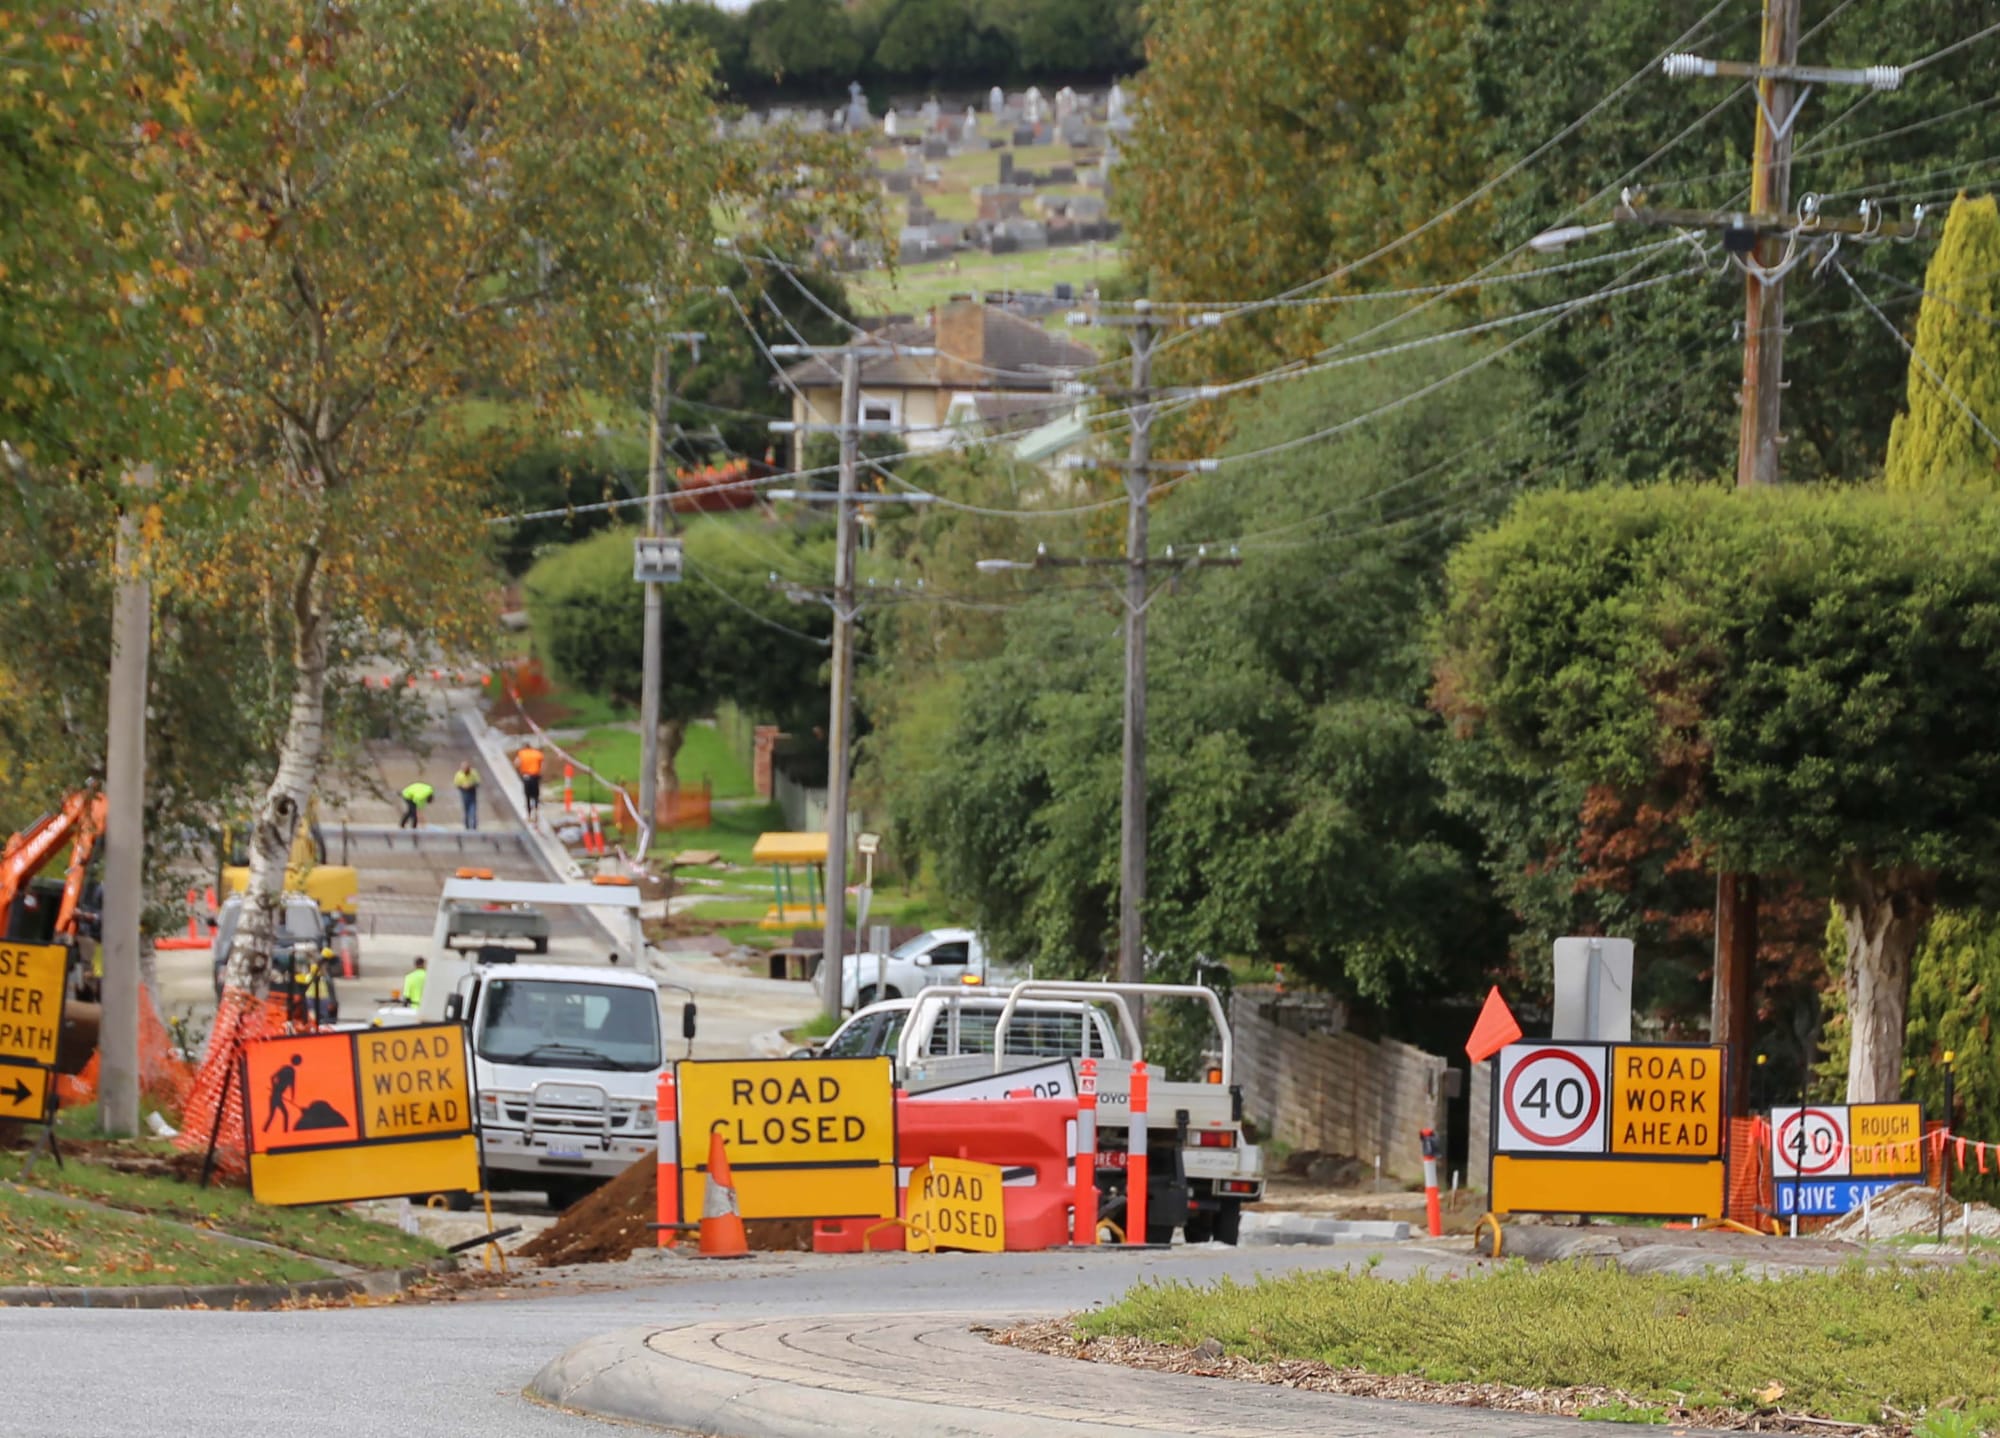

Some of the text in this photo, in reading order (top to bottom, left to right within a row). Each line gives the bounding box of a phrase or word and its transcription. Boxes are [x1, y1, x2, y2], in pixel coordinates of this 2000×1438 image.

[0, 950, 30, 978] SE
[0, 1024, 53, 1052] PATH
[371, 1036, 450, 1064] ROAD
[373, 1067, 453, 1095] WORK
[1627, 1056, 1706, 1080] ROAD
[732, 1077, 840, 1105] ROAD
[1520, 1077, 1585, 1120] 40
[1626, 1089, 1706, 1113] WORK
[376, 1099, 458, 1129] AHEAD
[1861, 1116, 1910, 1135] ROUGH
[709, 1115, 866, 1145] CLOSED
[1623, 1122, 1708, 1146] AHEAD
[1788, 1127, 1832, 1156] 40
[923, 1173, 983, 1202] ROAD
[1782, 1185, 1837, 1211] DRIVE
[911, 1207, 997, 1238] CLOSED
